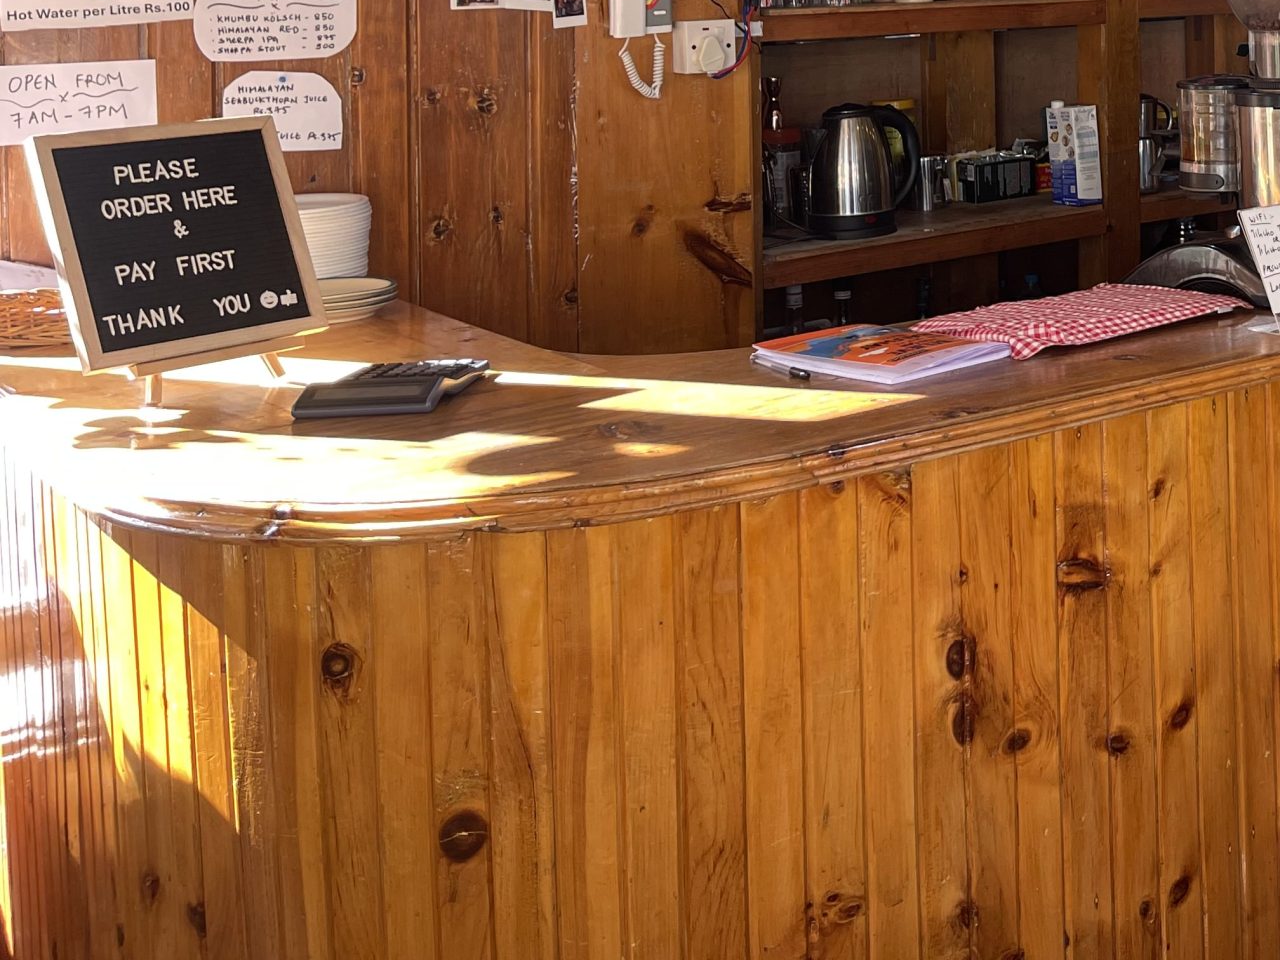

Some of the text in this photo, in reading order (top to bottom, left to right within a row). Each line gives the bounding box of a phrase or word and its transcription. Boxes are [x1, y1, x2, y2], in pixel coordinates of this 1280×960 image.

[7, 1, 190, 21] Hot Water per Litre Rs.100
[217, 15, 258, 23] KHUMBU
[218, 26, 269, 35] HIMALAYAN
[279, 25, 299, 33] RED
[8, 72, 123, 92] OPEN FROM
[238, 84, 294, 93] HIMALAYAN
[113, 158, 199, 185] PLEASE
[101, 186, 238, 220] ORDER HERE
[173, 219, 189, 238] &
[114, 250, 235, 286] PAY FIRST
[102, 293, 251, 337] THANK YOU
